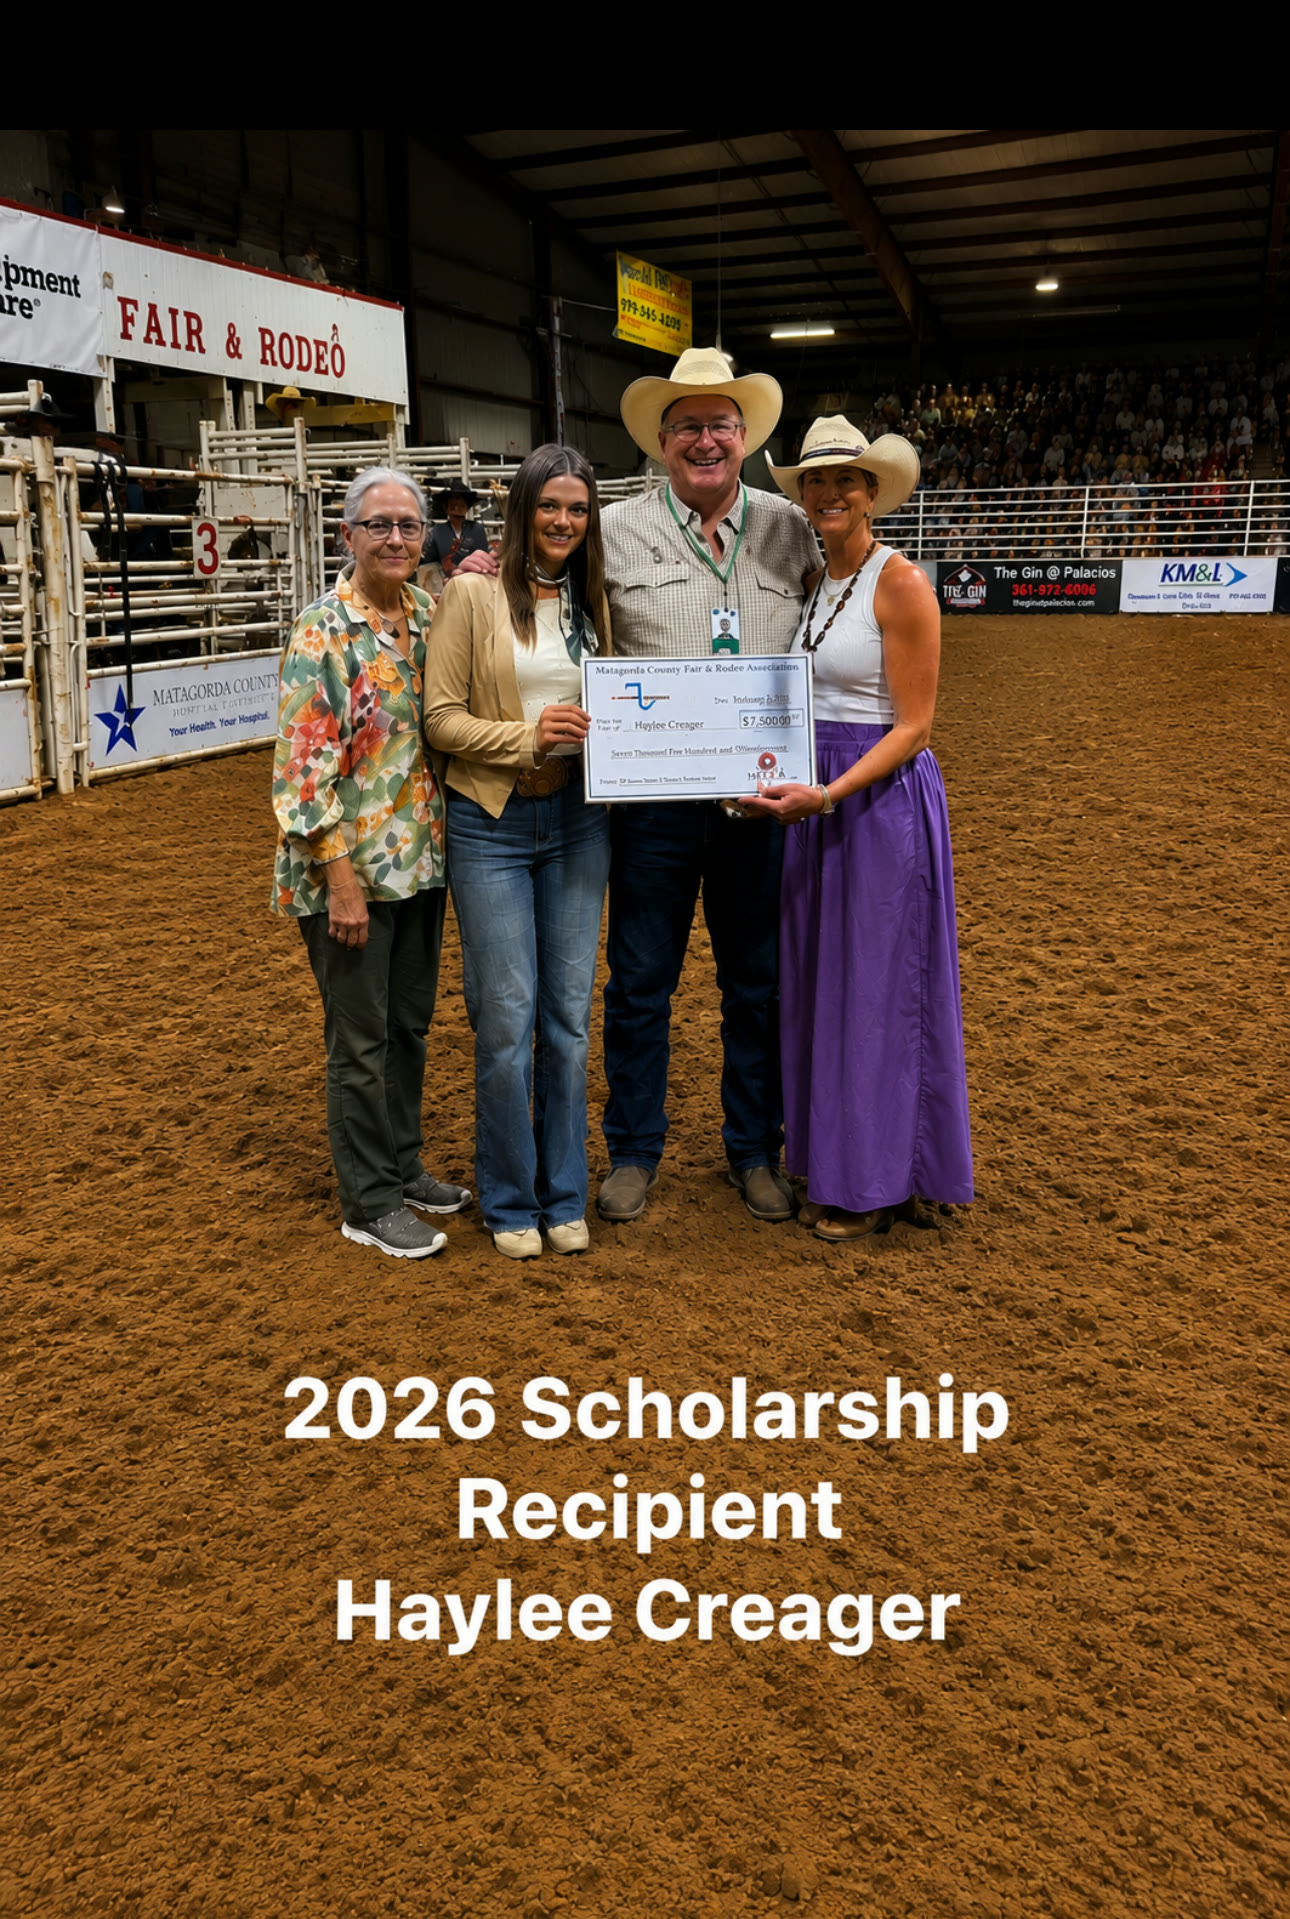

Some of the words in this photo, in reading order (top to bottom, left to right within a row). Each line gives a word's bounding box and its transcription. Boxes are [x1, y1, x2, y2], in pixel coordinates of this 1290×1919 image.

[117, 296, 206, 354] FAIR
[225, 322, 243, 360] &
[258, 323, 345, 378] RODEO
[197, 522, 219, 575] 3
[993, 566, 1018, 579] The
[1021, 566, 1043, 579] Gin
[1046, 565, 1061, 580] @
[1063, 565, 1117, 579] Palacios
[967, 585, 987, 598] GIN
[647, 665, 681, 675] County
[684, 664, 702, 673] Fair
[153, 681, 232, 707] MATAGORDA
[233, 673, 279, 694] COUNTY
[169, 727, 188, 737] Your
[219, 717, 236, 727] Your
